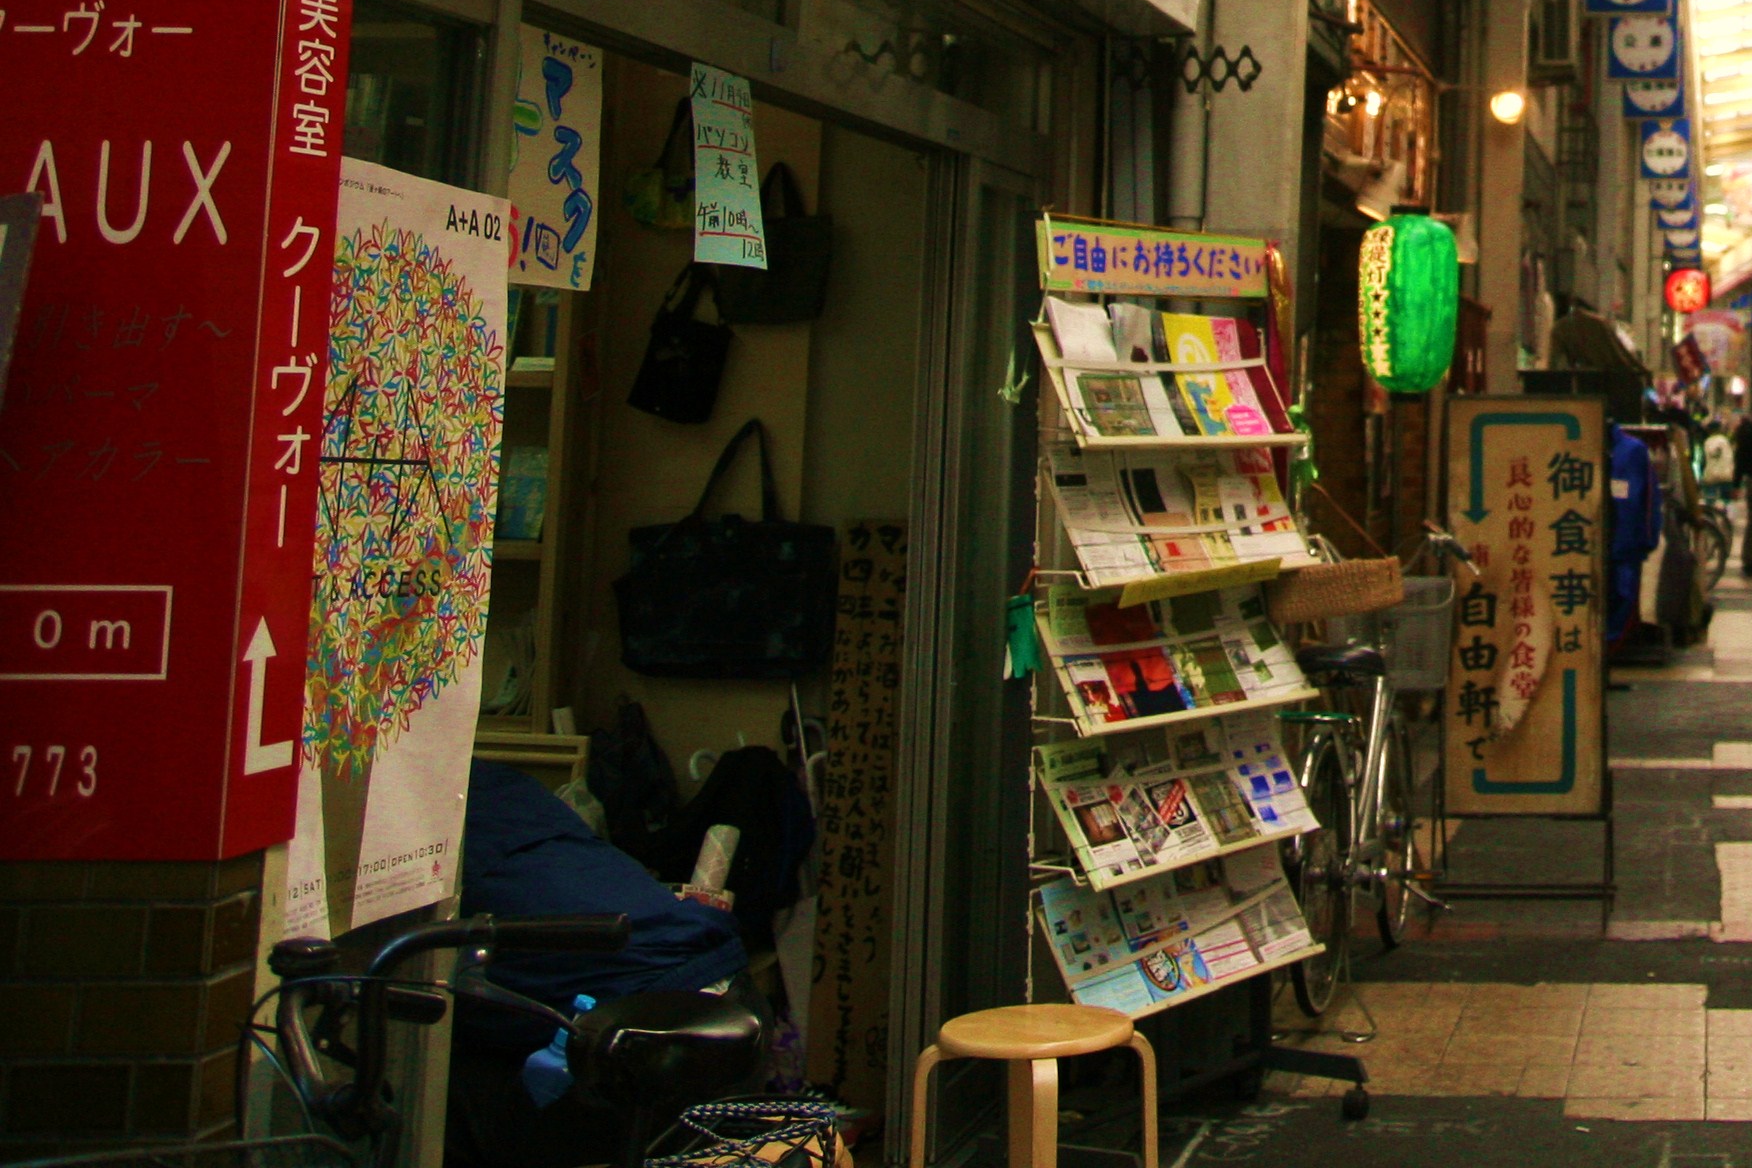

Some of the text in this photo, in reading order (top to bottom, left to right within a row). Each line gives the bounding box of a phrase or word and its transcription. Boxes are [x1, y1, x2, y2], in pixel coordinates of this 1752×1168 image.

[446, 204, 480, 238] A+A
[484, 212, 502, 242] 02
[1053, 232, 1264, 281] ご自由にお持ちください
[268, 216, 321, 549] クーヴォー
[1505, 454, 1540, 701] 良心的な皆様の食堂
[1546, 451, 1596, 656] 御食事は
[1454, 580, 1501, 762] 自由軒で
